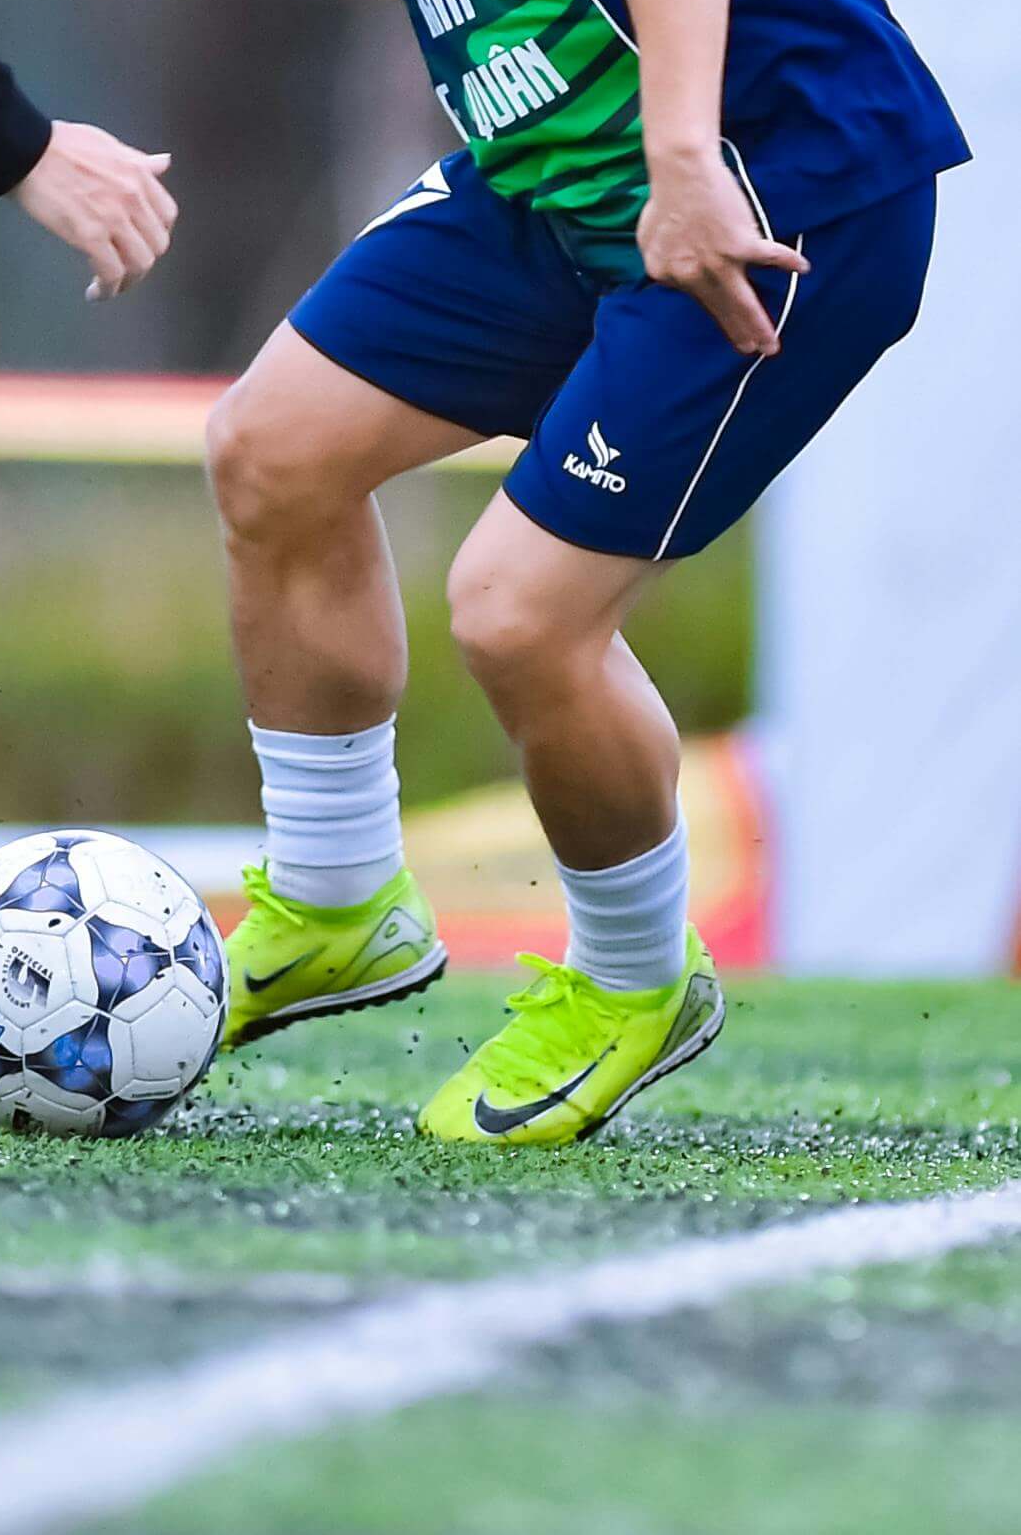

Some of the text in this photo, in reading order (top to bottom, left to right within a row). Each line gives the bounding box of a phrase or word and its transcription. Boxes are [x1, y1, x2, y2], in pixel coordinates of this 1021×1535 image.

[462, 38, 570, 142] QUÂN
[563, 453, 626, 493] KAMITO
[11, 946, 53, 980] OFFICIAL
